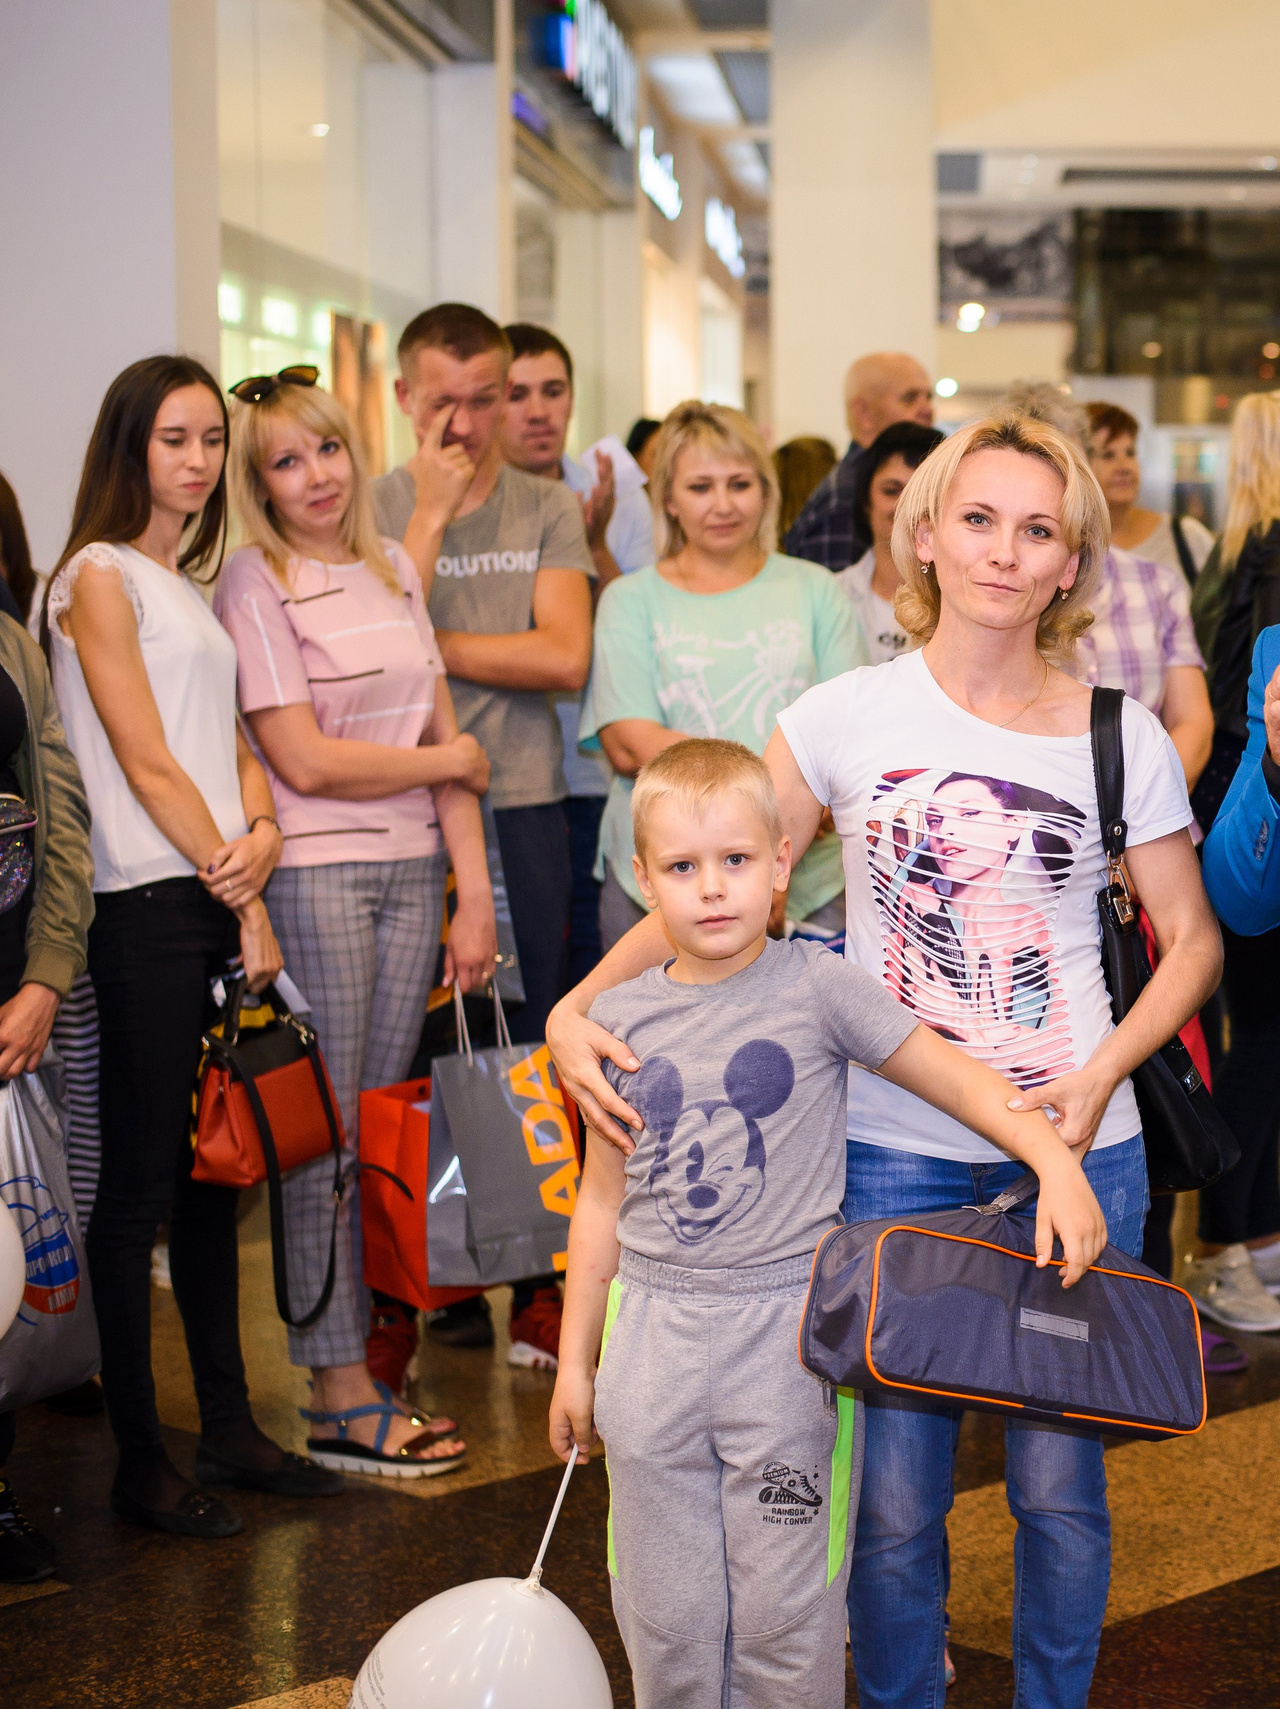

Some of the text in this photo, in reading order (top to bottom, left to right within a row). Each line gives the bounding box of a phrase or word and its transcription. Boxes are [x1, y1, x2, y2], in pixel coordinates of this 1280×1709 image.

[508, 1044, 582, 1273] ADA
[763, 1467, 790, 1479] PREMIUM
[771, 1507, 806, 1517] RAINBOW
[762, 1514, 813, 1526] HIGH CONVER
